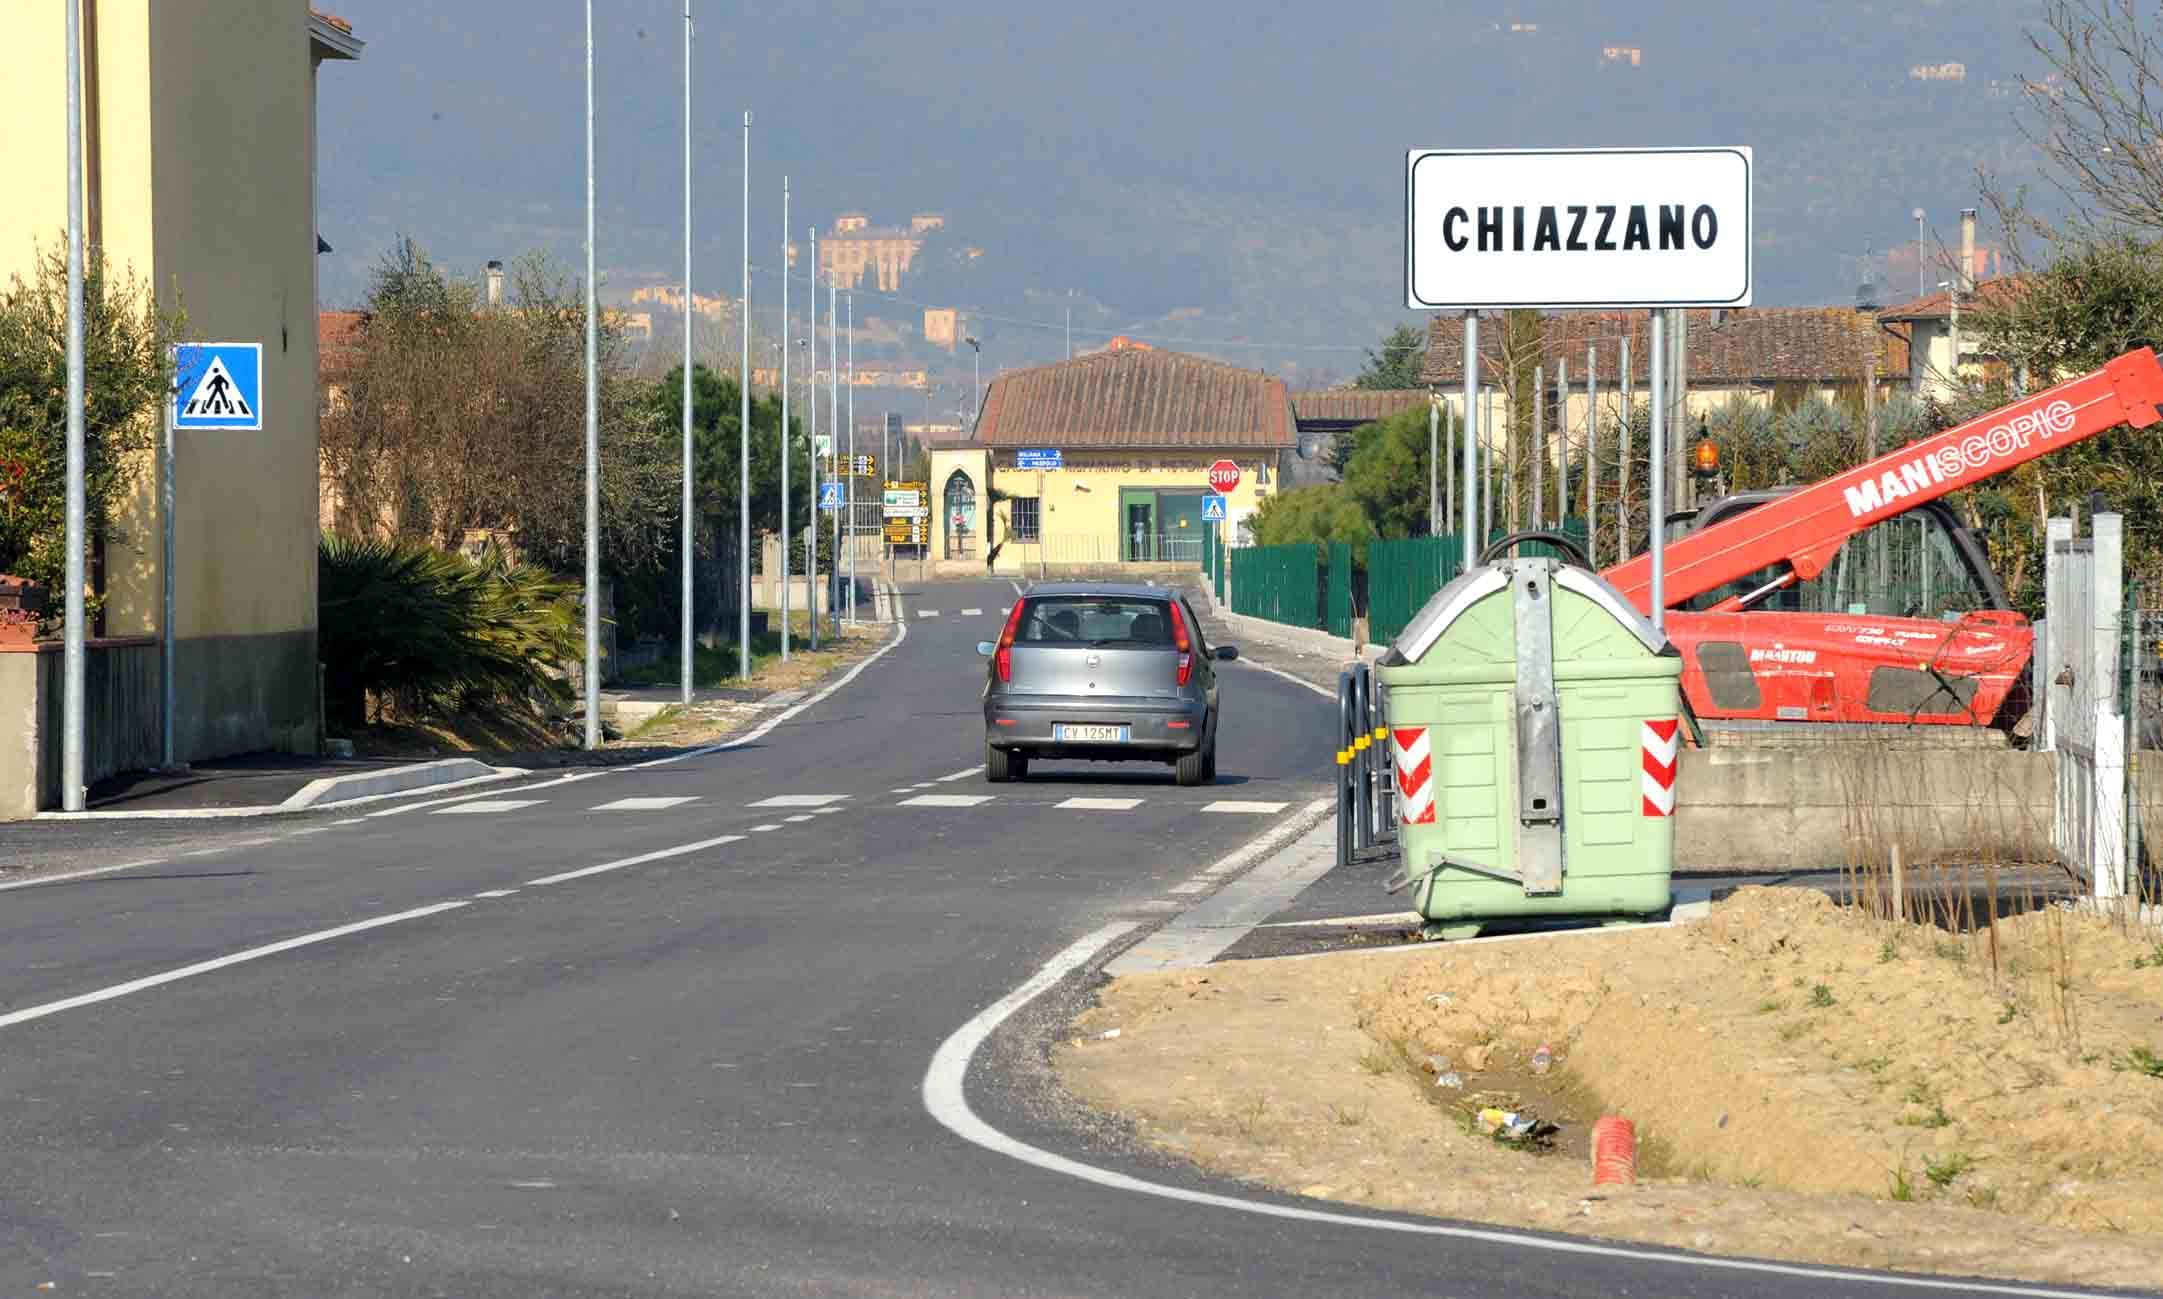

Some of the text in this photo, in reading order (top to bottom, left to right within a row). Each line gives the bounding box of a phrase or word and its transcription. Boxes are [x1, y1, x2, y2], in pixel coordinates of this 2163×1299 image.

[1442, 203, 1719, 253] CHIAZZANO
[1210, 470, 1239, 484] STOP
[1843, 400, 2077, 518] MANISCOPIC
